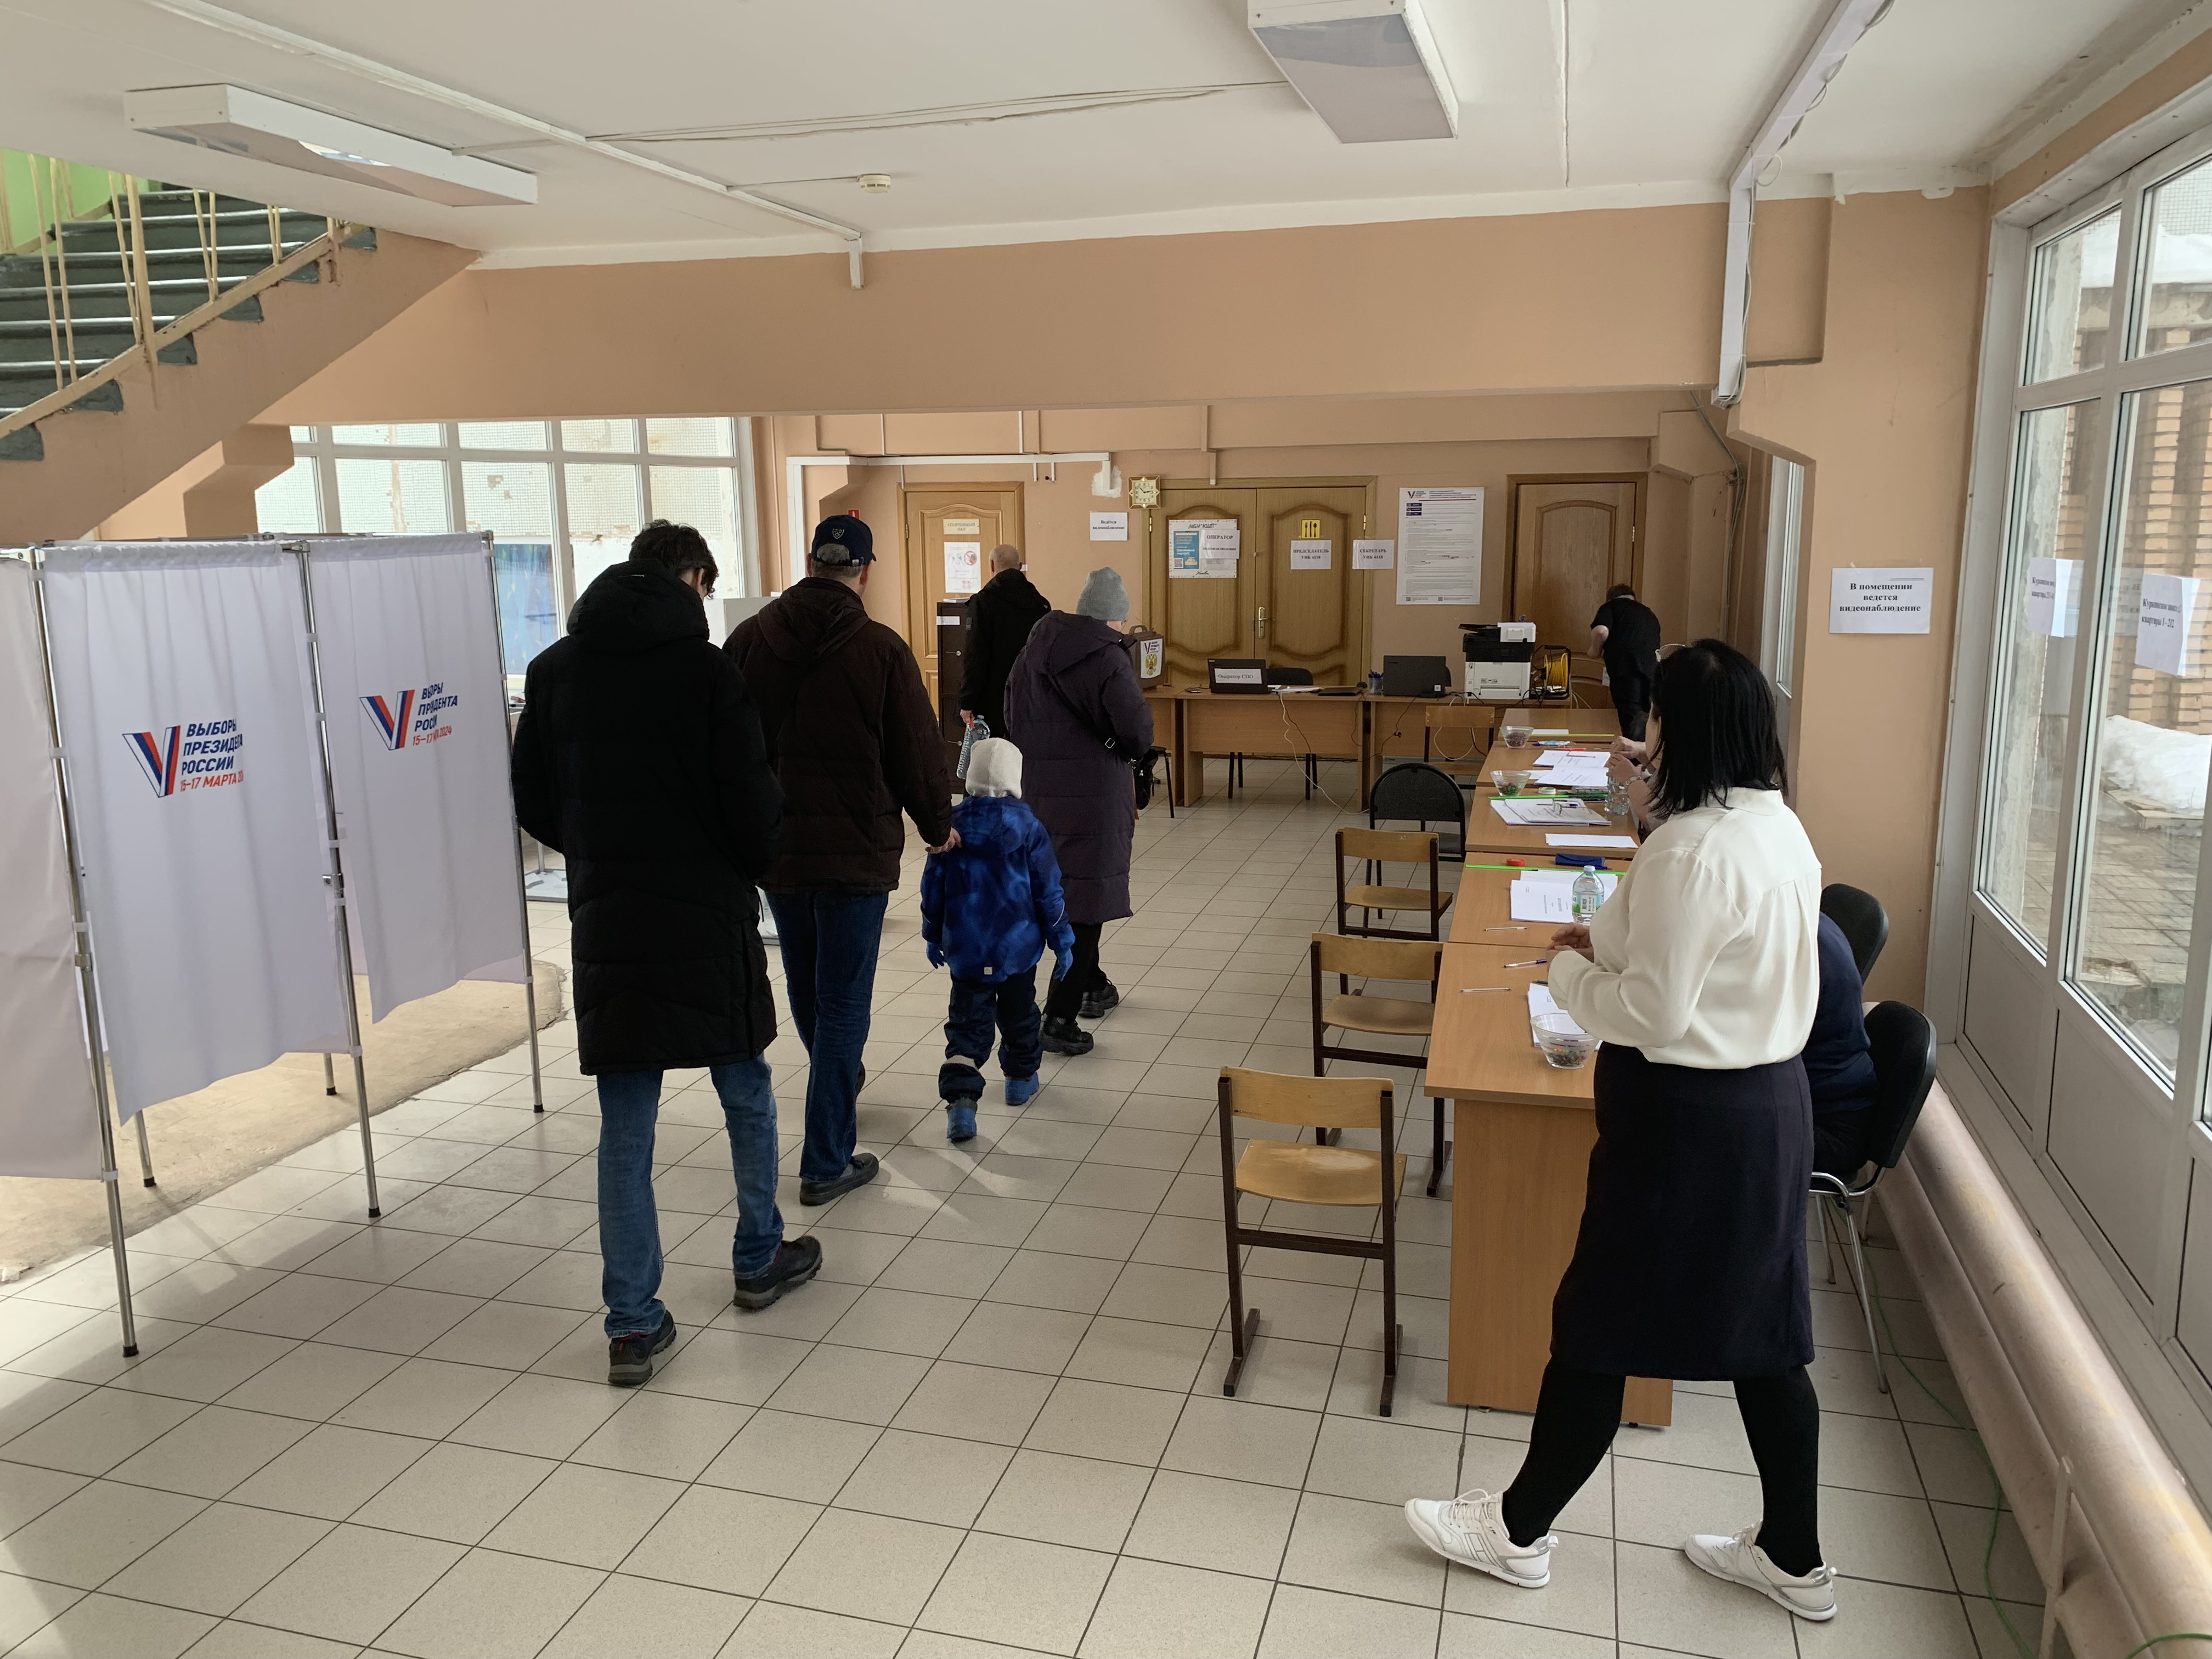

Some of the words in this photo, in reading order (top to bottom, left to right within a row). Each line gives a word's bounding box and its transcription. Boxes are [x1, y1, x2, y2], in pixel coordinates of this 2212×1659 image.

[1859, 583, 1912, 591] помещении
[1839, 604, 1921, 612] видеонаблюдение
[182, 755, 234, 776] РОССИИ
[202, 773, 236, 788] МАРТА
